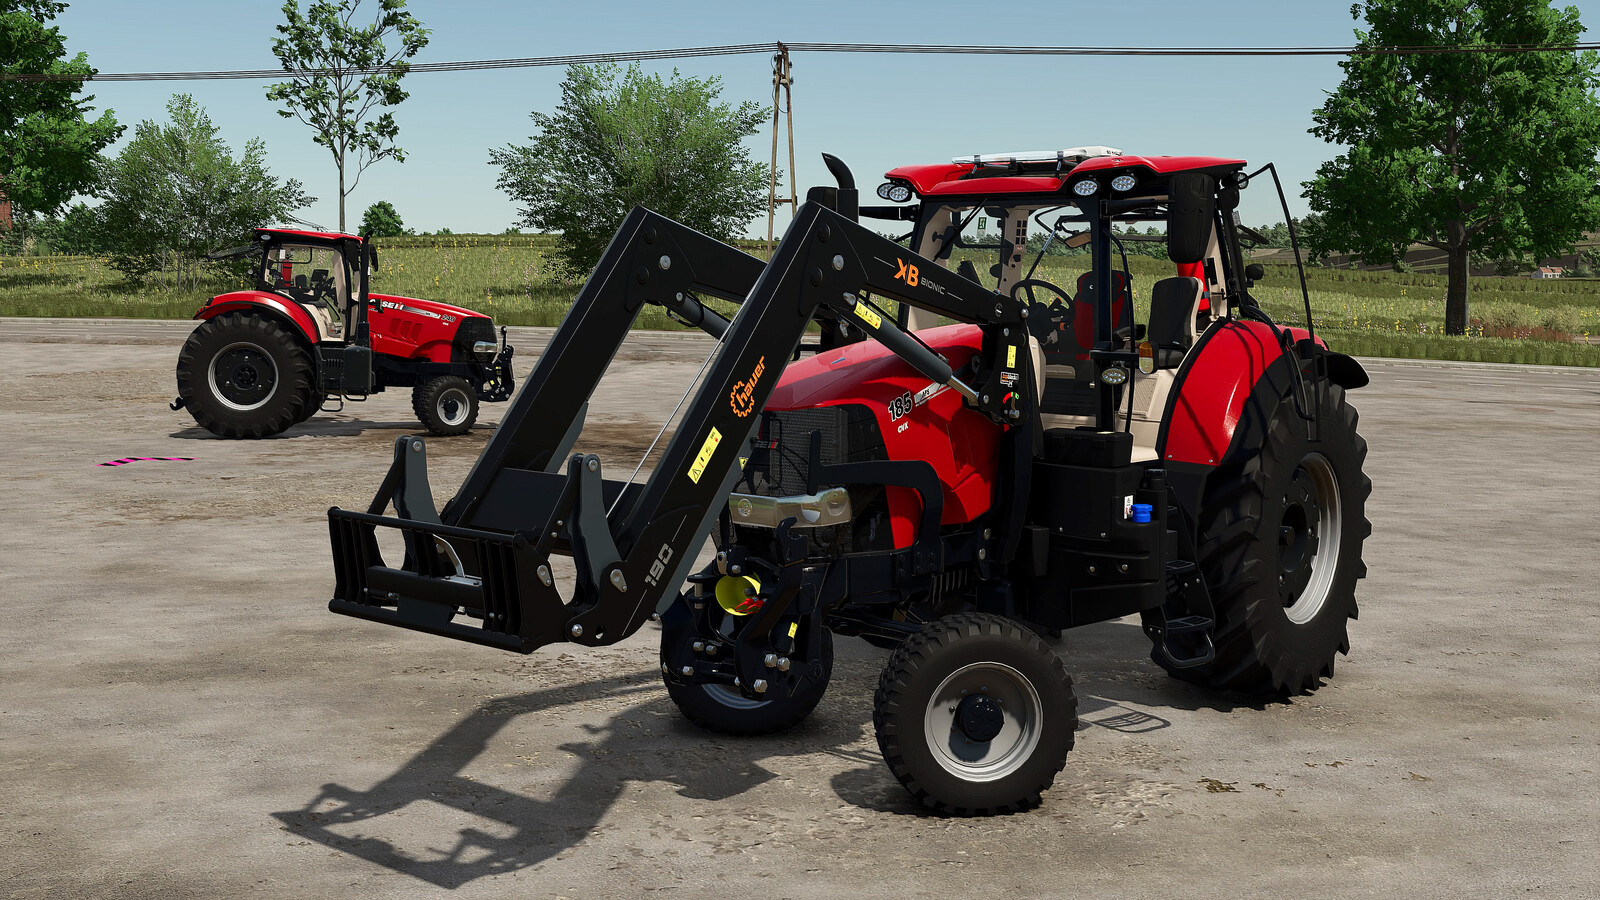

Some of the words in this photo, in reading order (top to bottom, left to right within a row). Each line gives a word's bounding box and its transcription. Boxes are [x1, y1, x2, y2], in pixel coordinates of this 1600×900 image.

[920, 276, 946, 295] BIONIC
[735, 355, 766, 408] hauer
[888, 391, 913, 422] 185
[897, 421, 909, 433] CVX
[644, 542, 674, 587] 190
